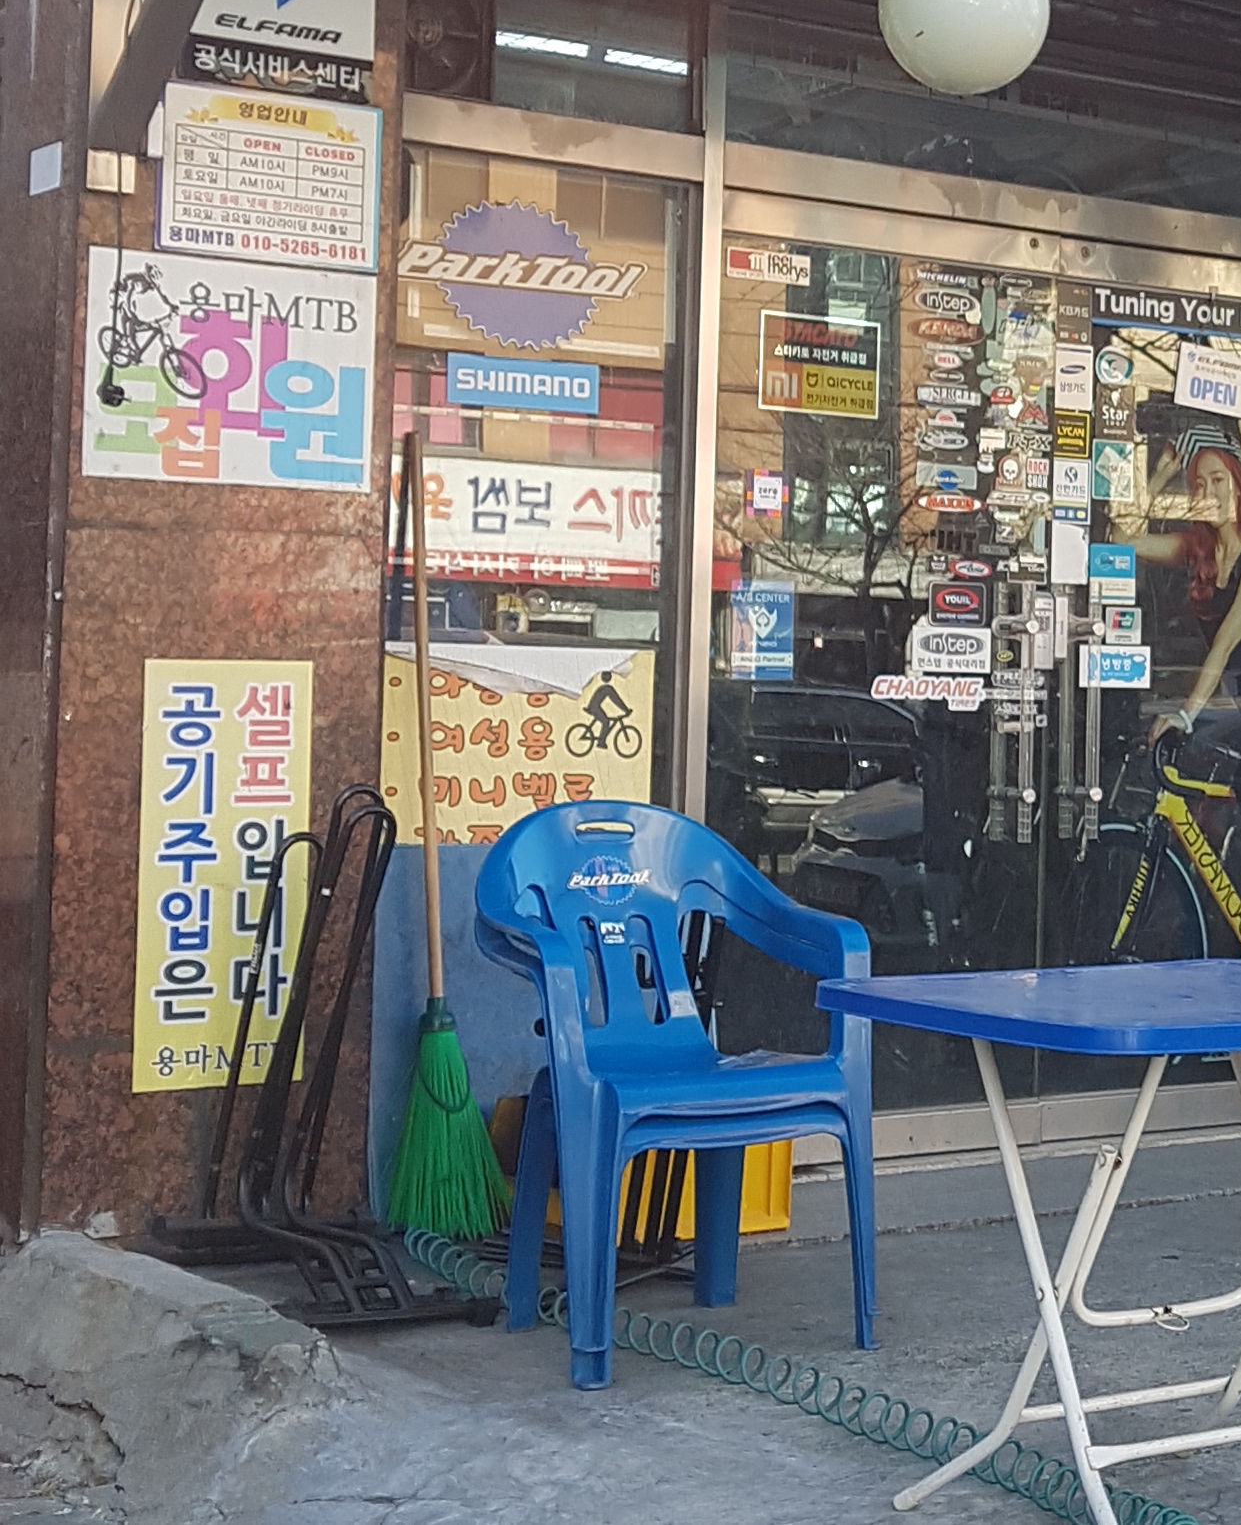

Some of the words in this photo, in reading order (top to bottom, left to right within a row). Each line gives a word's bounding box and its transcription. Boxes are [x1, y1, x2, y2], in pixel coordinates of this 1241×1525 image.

[215, 12, 342, 45] ELFAMA
[194, 43, 361, 92] 공식서비스센터
[239, 102, 307, 125] 영업안내
[243, 137, 281, 152] OPEN
[305, 146, 355, 161] CLOSED
[240, 156, 285, 173] AM10시
[312, 164, 348, 180] PM9시
[240, 176, 285, 192] AM10시
[312, 185, 348, 201] PM7시
[241, 234, 366, 262] 010-5265-6181
[398, 239, 647, 299] ParkTool
[917, 269, 966, 287] MICHELIN
[180, 281, 358, 333] 용마MTB
[1095, 287, 1174, 323] Tuning
[1181, 298, 1235, 328] Your
[456, 368, 590, 400] SHIMANO
[1190, 377, 1237, 406] OPEN
[756, 593, 790, 604] CENTER
[944, 595, 971, 605] YOUIL
[873, 678, 981, 698] CHAOYANG
[951, 698, 977, 708] TIRES
[429, 716, 555, 761] 여성용
[152, 683, 222, 1023] 공기주입은
[151, 1042, 278, 1078] 용마MT
